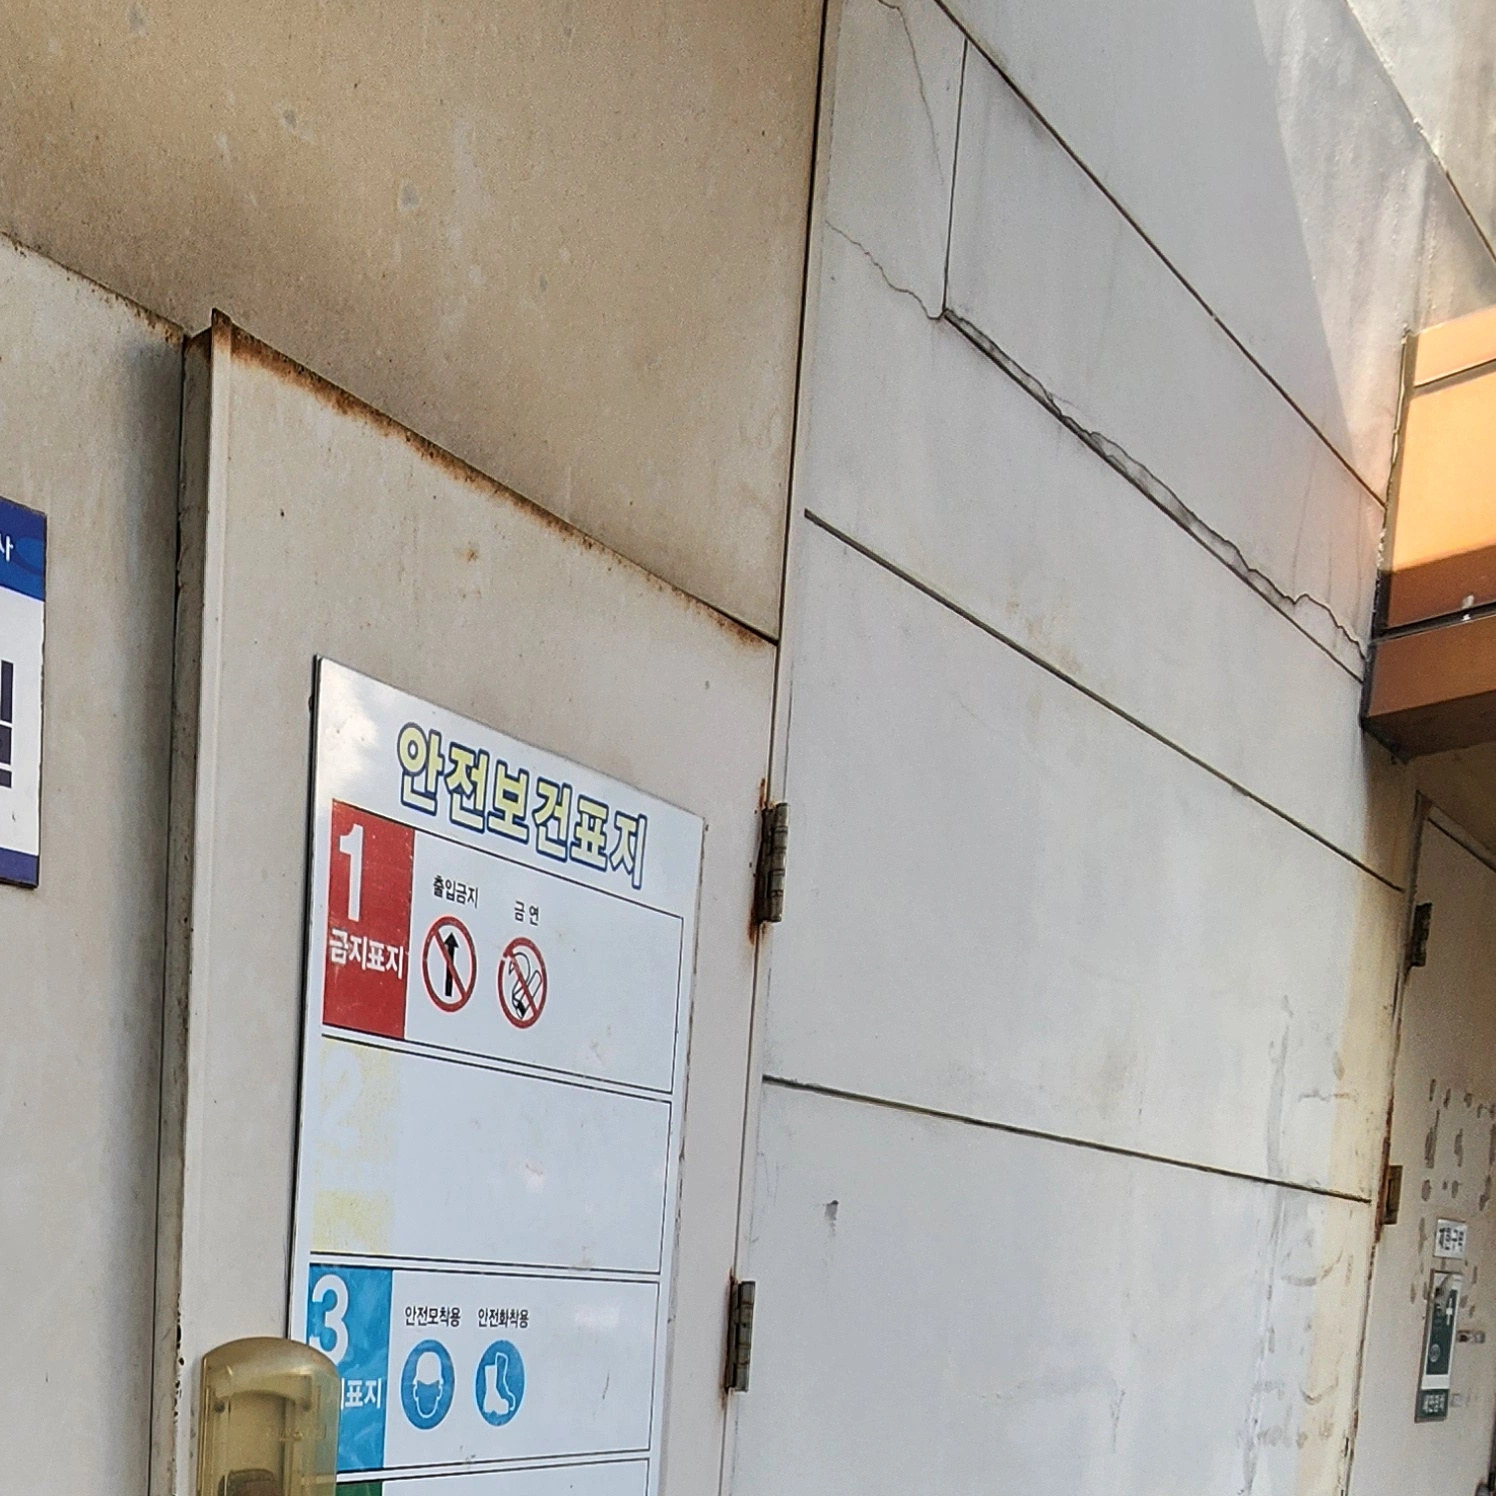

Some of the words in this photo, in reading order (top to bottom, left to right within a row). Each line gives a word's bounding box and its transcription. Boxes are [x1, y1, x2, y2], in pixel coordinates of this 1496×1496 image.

[397, 722, 648, 890] 안전보건표지
[339, 823, 364, 922] 1
[433, 875, 478, 909] 출입금지
[329, 928, 404, 979] 금지표지
[309, 1273, 349, 1367] 3
[405, 1305, 461, 1328] 안전모착용
[478, 1307, 530, 1329] 안전화착용
